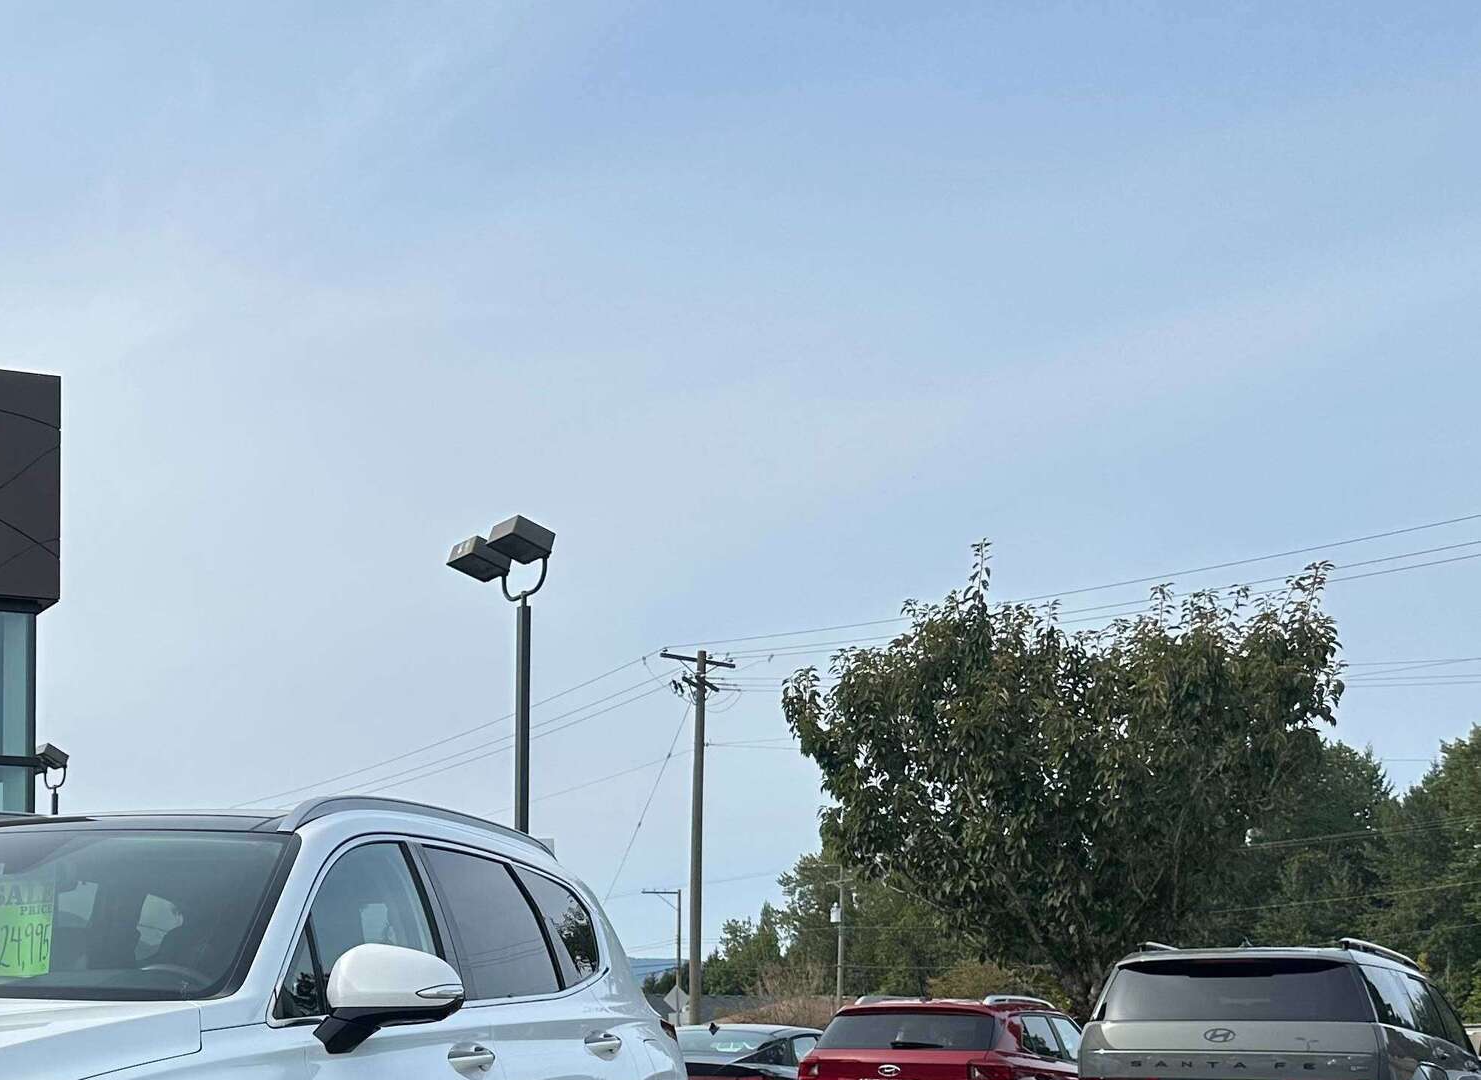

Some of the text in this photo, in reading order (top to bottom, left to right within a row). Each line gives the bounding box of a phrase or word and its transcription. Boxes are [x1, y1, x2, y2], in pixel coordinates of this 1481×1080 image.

[19, 903, 53, 917] PRICE
[1130, 1060, 1317, 1070] SANTA FE
